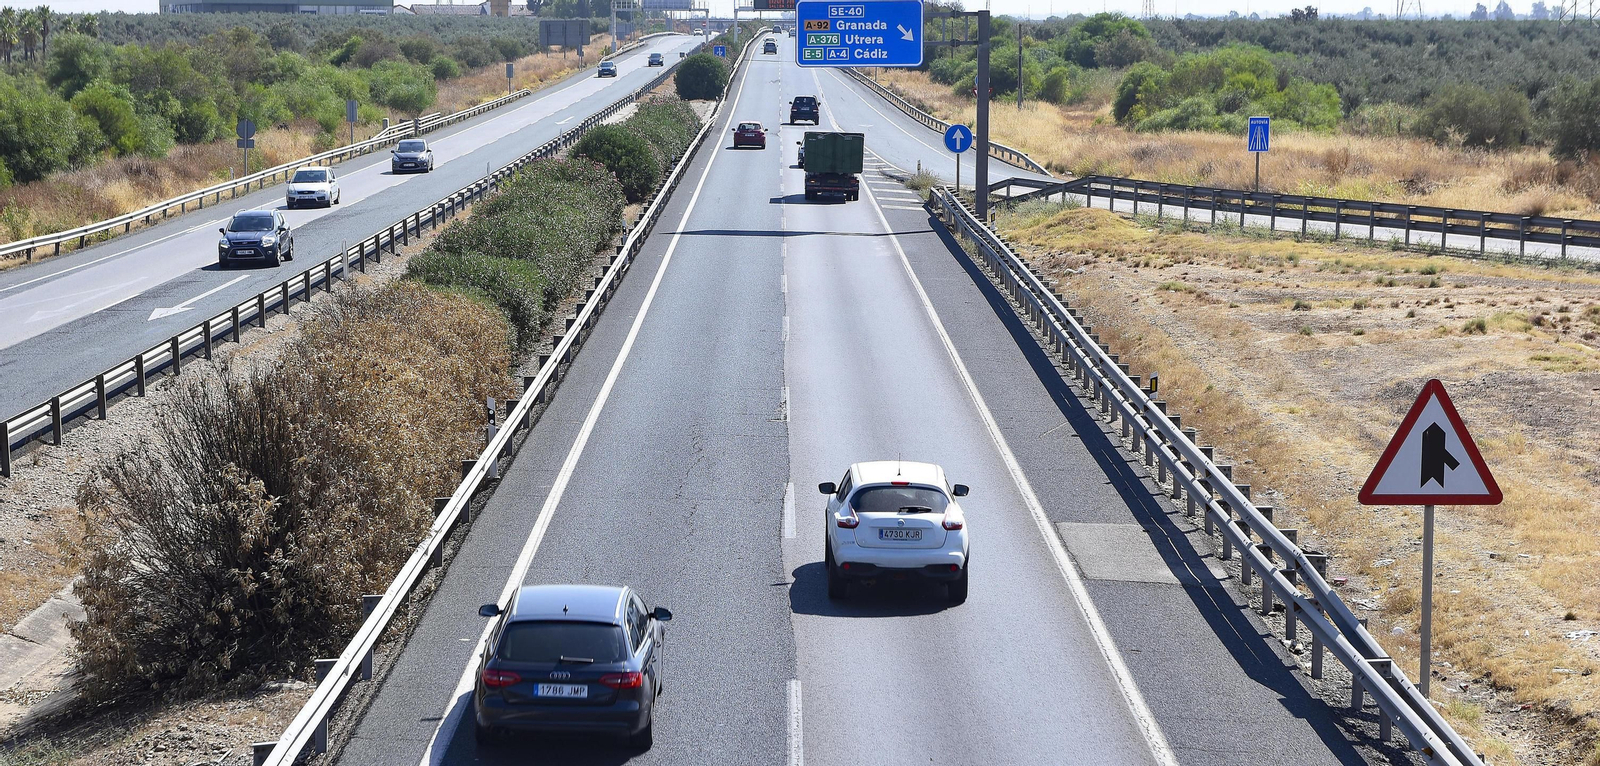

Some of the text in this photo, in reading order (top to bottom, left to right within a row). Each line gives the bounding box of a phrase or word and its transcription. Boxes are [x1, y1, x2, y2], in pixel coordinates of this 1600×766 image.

[831, 8, 862, 16] SE-40
[806, 20, 887, 30] A-92 Granada
[809, 35, 883, 45] A-376 Utrera
[805, 49, 888, 59] E-5 A-4 Cádiz
[541, 685, 585, 697] 1786 JMP
